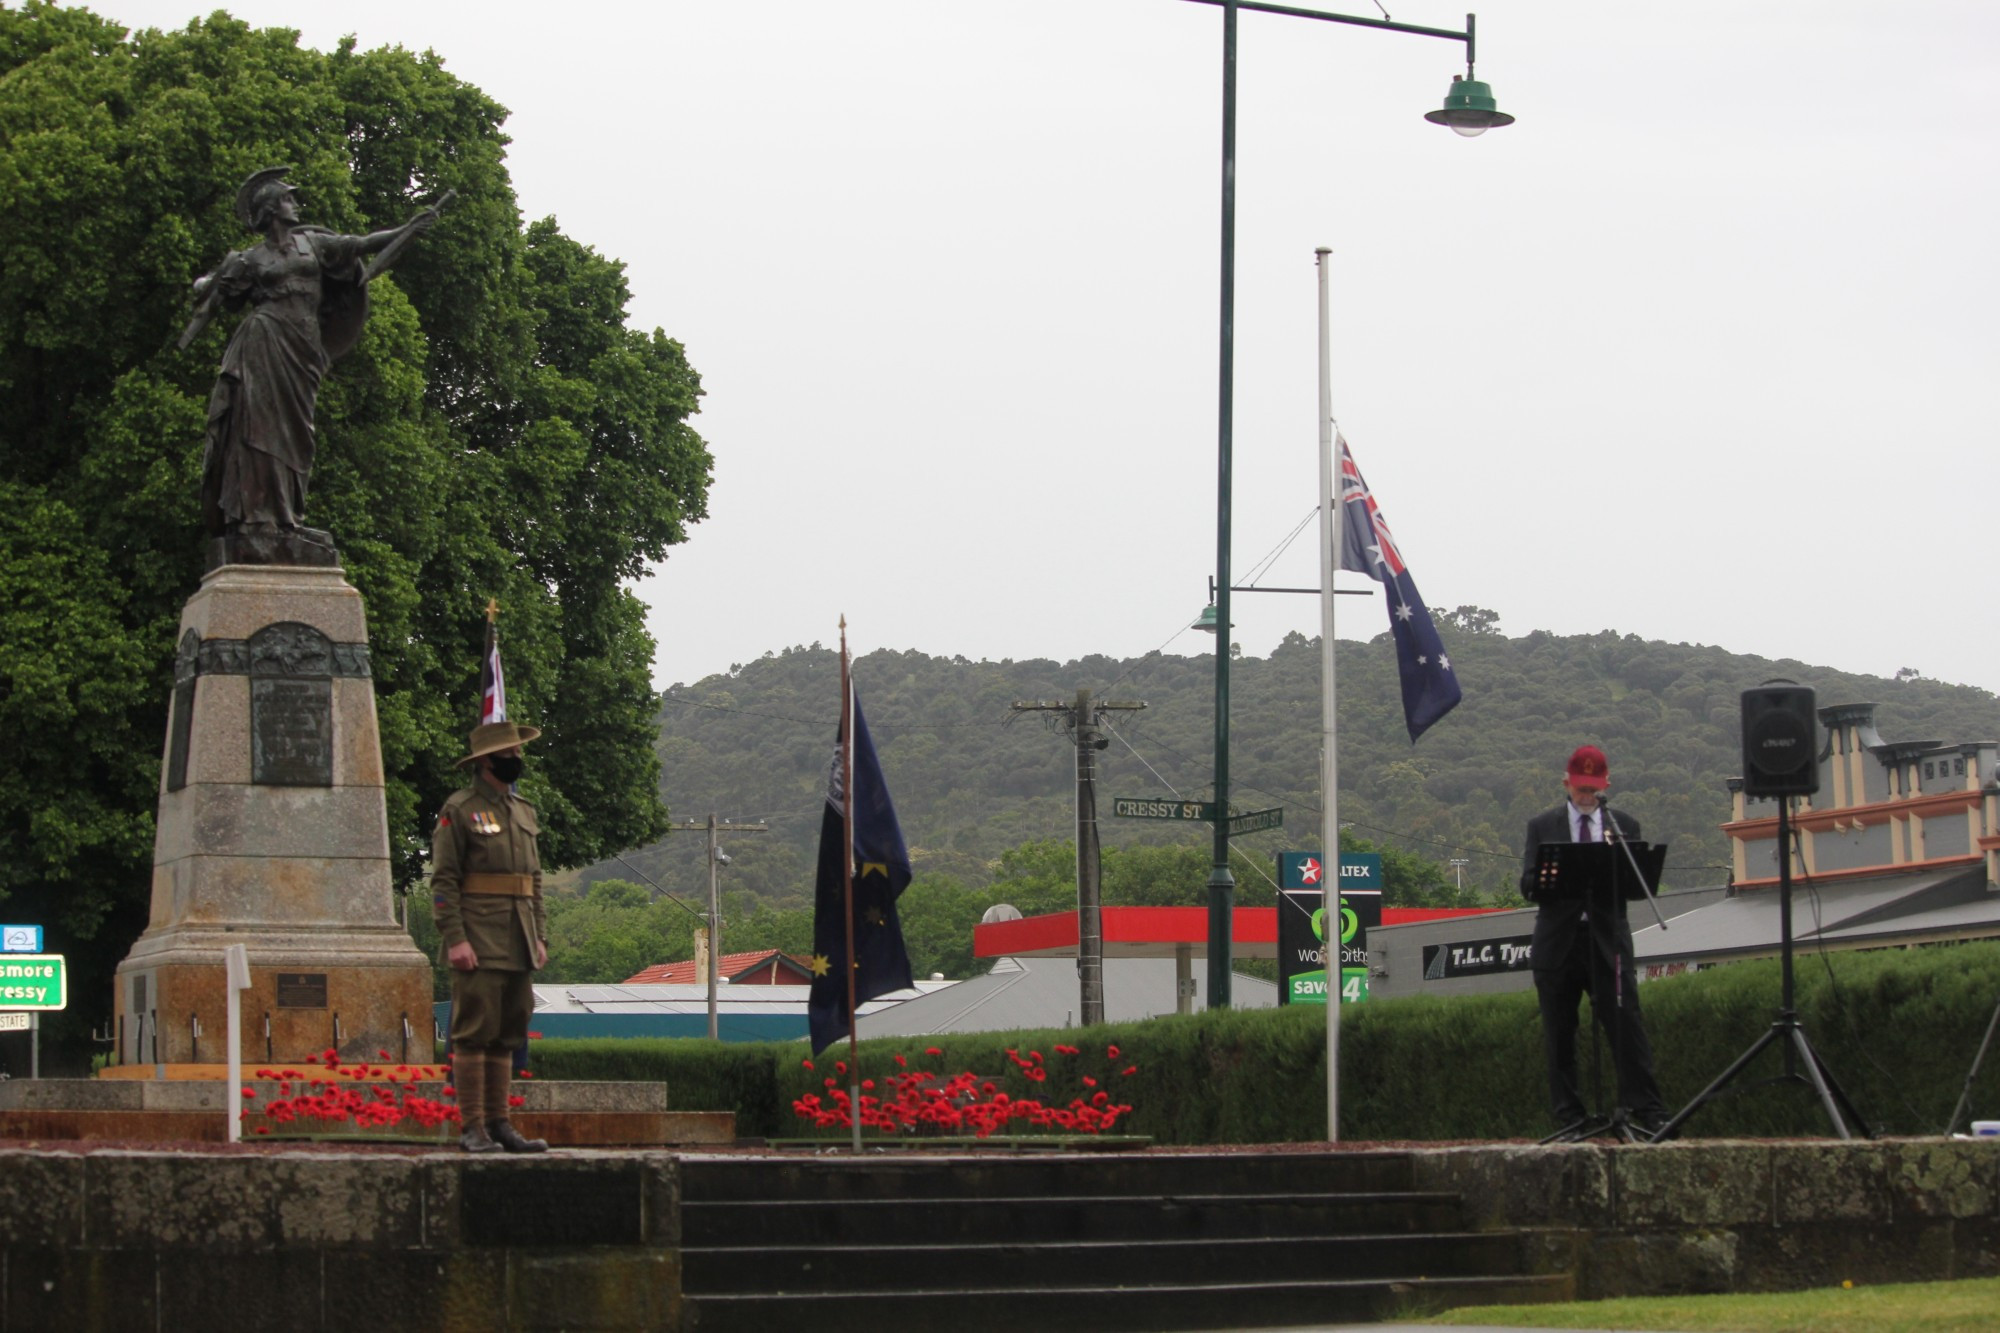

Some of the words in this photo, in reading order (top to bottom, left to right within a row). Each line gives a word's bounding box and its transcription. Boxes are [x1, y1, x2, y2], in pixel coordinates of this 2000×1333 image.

[1116, 801, 1178, 818] CRESSY
[1183, 804, 1202, 819] ST
[1270, 809, 1280, 826] ST
[1453, 945, 1494, 966] T.L.C.
